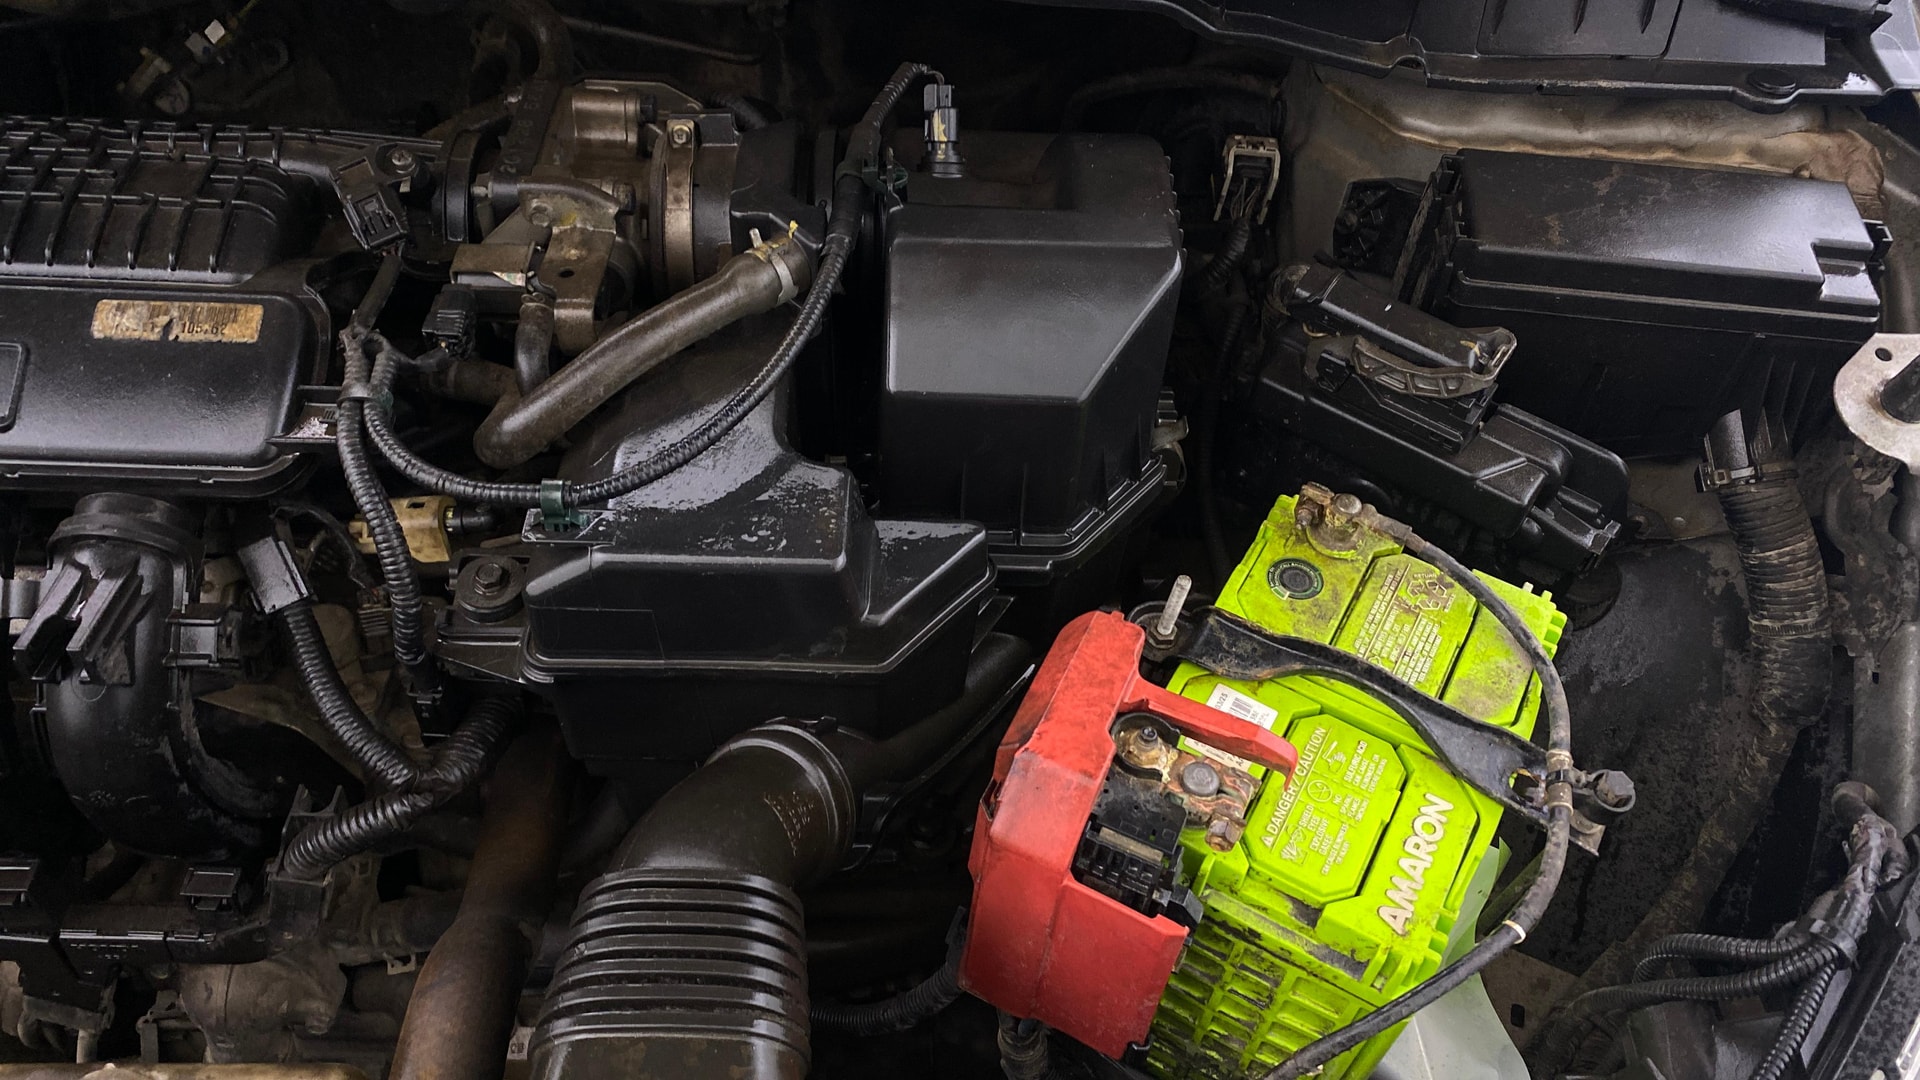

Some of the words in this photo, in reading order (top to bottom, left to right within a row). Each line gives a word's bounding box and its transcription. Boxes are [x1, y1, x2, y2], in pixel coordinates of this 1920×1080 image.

[1266, 784, 1298, 835] DANGER
[1294, 726, 1326, 778] CAUTION
[1378, 793, 1454, 936] AMARON
